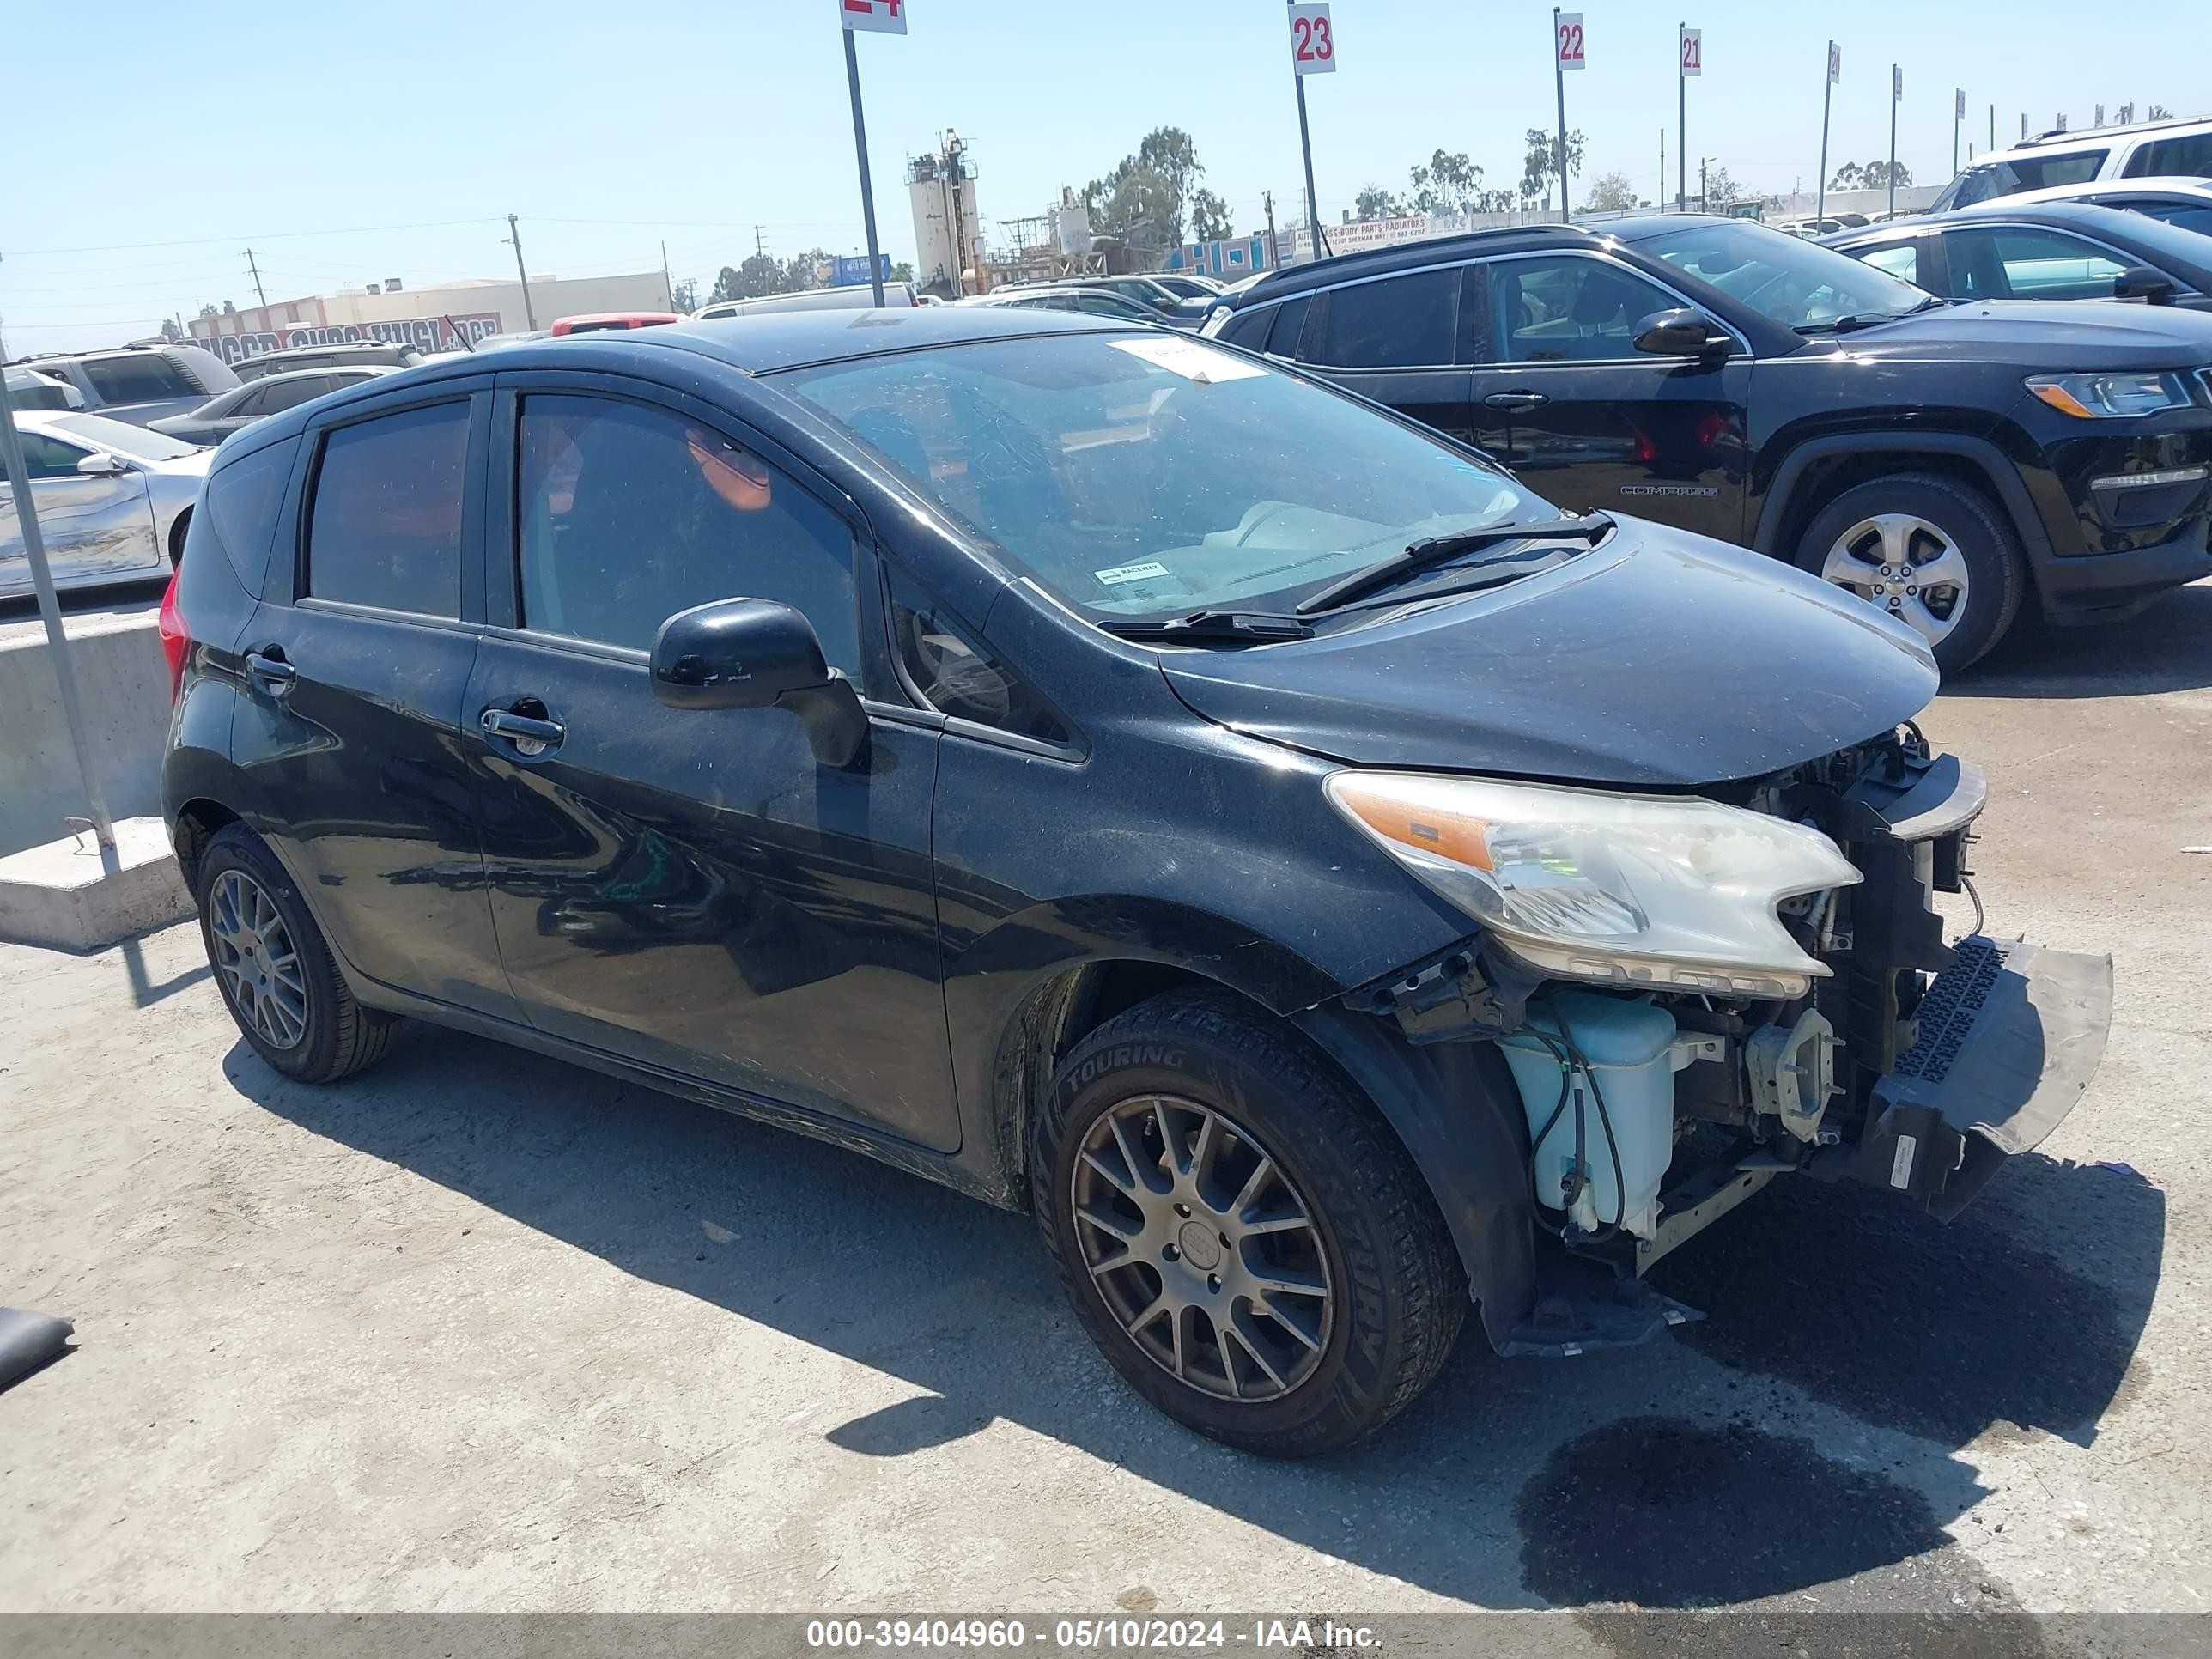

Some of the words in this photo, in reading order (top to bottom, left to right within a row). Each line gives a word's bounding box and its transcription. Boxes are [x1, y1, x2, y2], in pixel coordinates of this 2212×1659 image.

[1293, 16, 1333, 61] 23
[1559, 24, 1584, 60] 22
[1683, 37, 1701, 68] 21
[1831, 50, 1840, 77] 20
[1620, 485, 1719, 497] COMPASS
[1121, 564, 1158, 574] RACEWAY
[1067, 1045, 1188, 1093] TOURING
